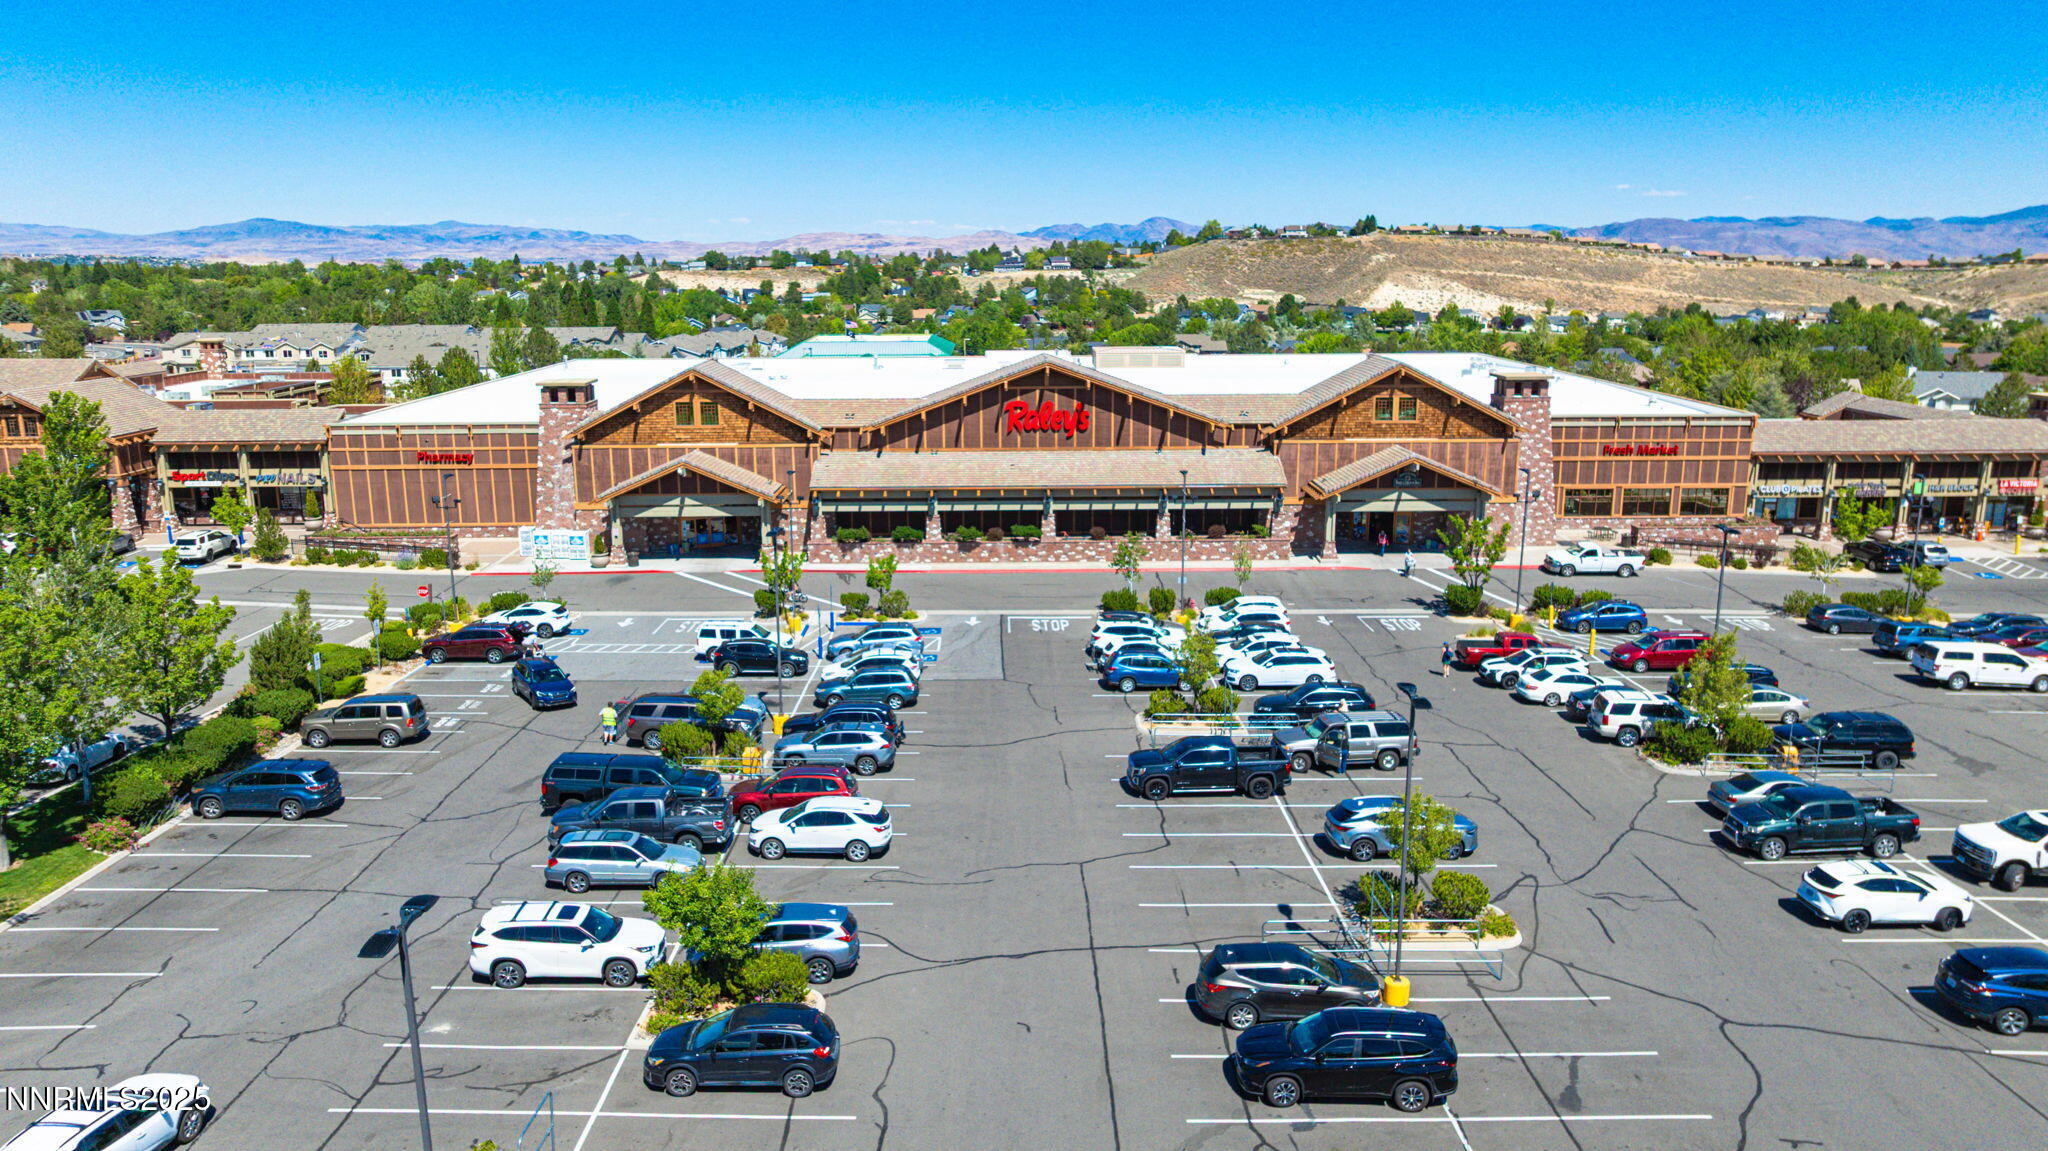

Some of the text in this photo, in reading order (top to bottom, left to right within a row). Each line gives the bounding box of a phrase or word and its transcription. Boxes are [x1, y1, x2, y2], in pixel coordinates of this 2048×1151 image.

[1004, 401, 1090, 438] Raley's
[1602, 445, 1679, 456] Fresh Market
[416, 452, 474, 465] Pharmacy
[172, 471, 206, 483] Sport
[277, 473, 316, 485] NAILS
[1760, 485, 1824, 495] CLUB PILATES
[1031, 619, 1070, 631] STOP
[1380, 618, 1422, 631] STOP
